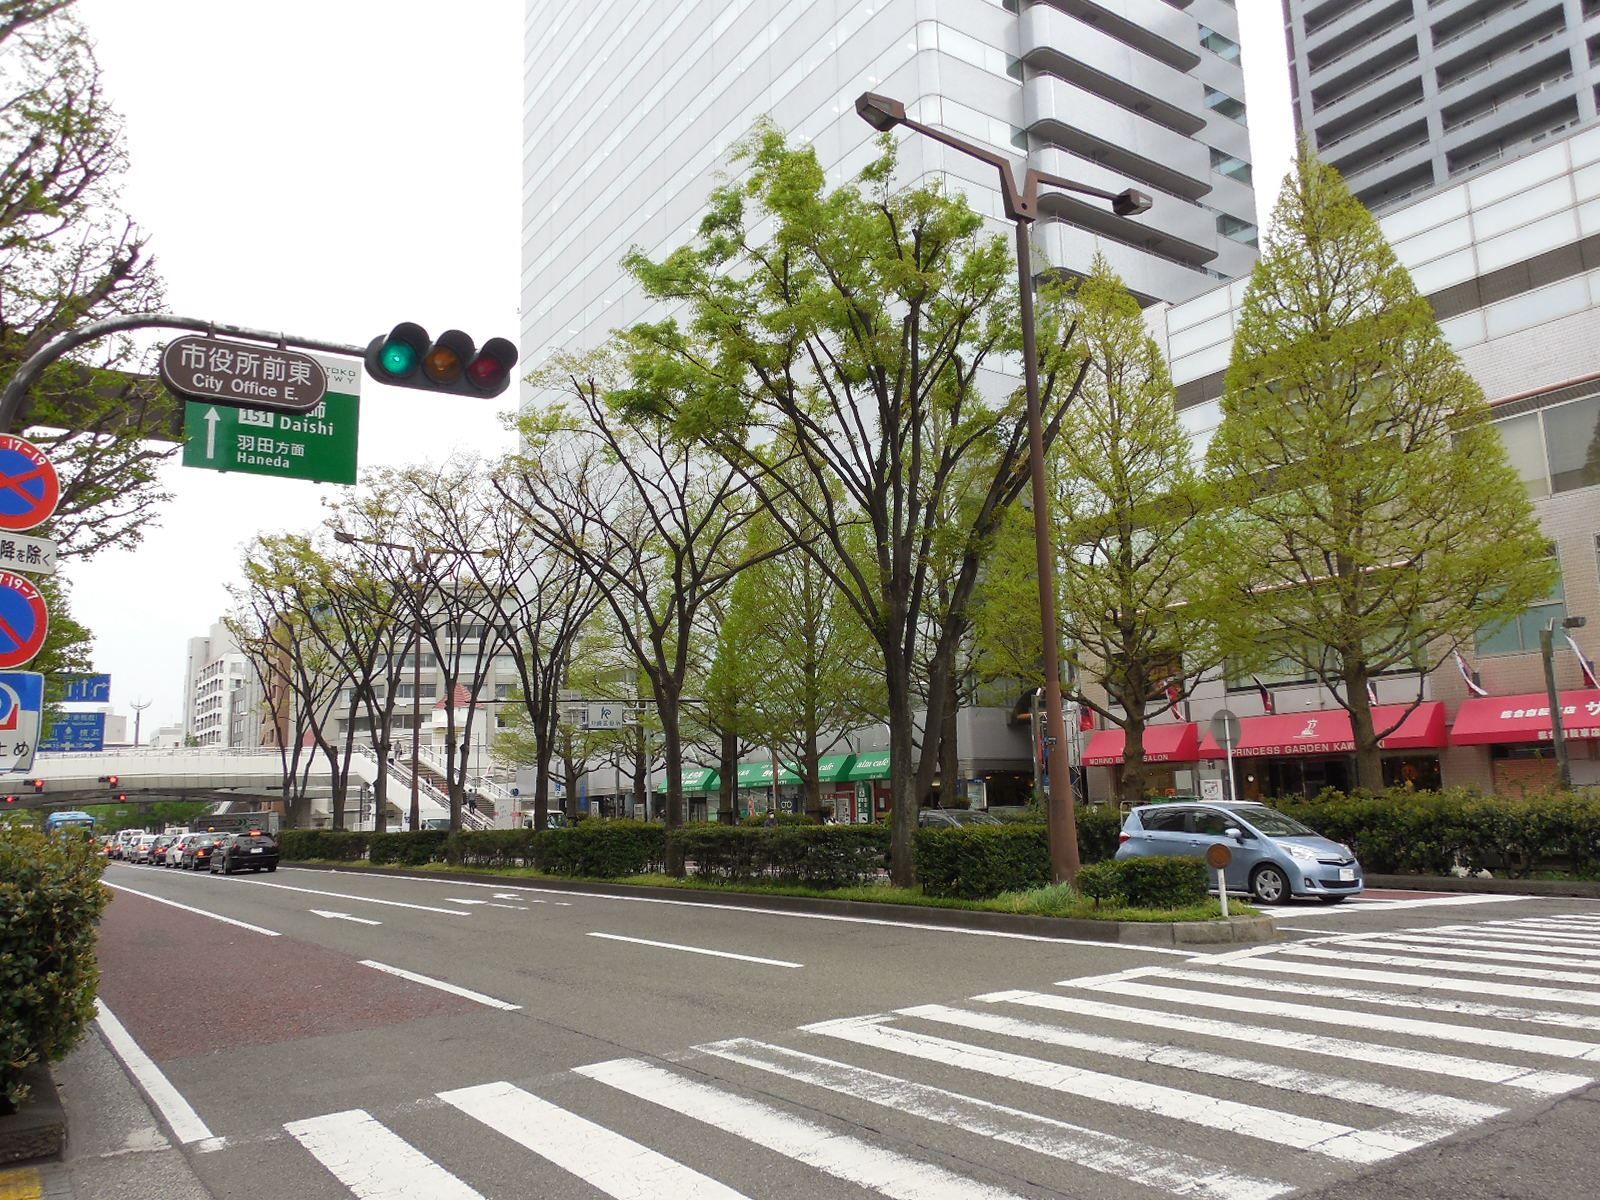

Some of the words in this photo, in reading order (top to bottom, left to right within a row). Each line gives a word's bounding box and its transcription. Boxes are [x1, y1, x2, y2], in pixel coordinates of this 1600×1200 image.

[180, 343, 312, 386] 市役所前東
[192, 373, 223, 393] City
[231, 378, 277, 398] Office
[284, 386, 299, 401] E.
[280, 416, 334, 436] Daishi
[237, 435, 305, 457] 羽田方面
[237, 452, 290, 469] Haneda
[0, 539, 50, 567] 降を除く
[1500, 706, 1577, 719] 総合自転店
[1143, 753, 1169, 763] SALON
[1231, 746, 1281, 757] PRINCESS
[1285, 743, 1329, 754] GARDEN
[1333, 739, 1385, 751] KAWKI
